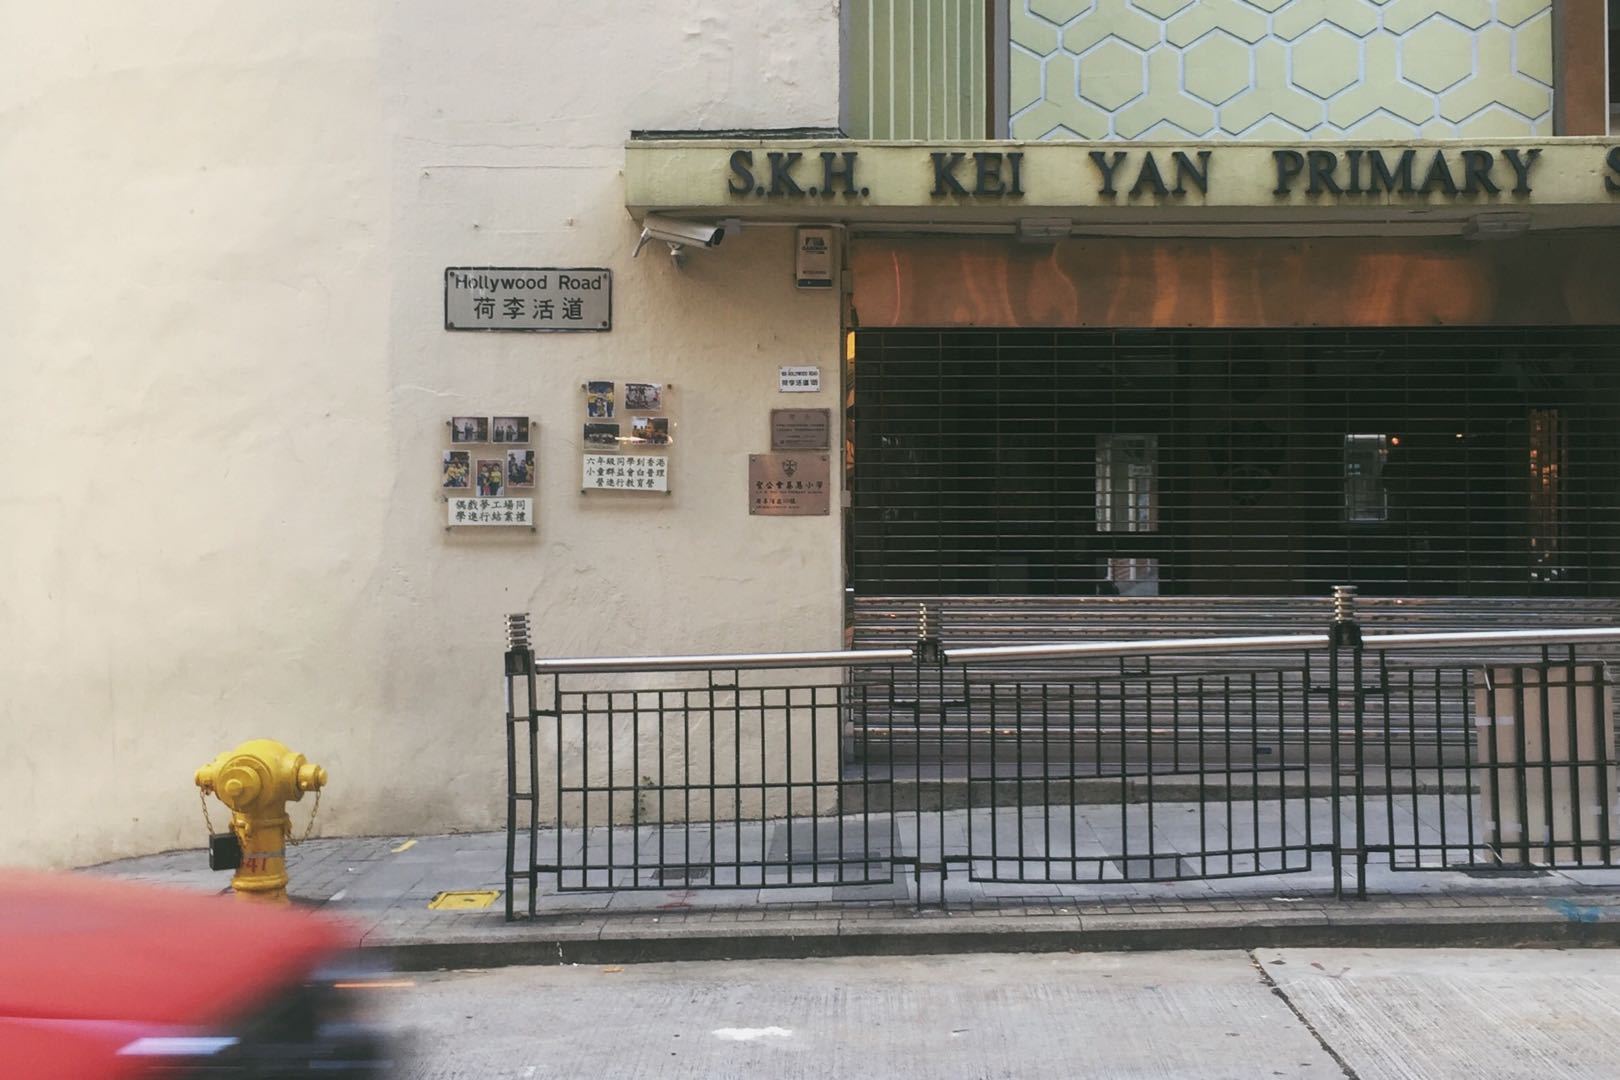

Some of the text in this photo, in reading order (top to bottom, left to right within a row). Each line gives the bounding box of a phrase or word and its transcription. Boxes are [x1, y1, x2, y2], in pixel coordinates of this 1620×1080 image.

[728, 150, 870, 197] S.K.H.
[930, 151, 1025, 196] KEI
[1088, 150, 1212, 196] YAN
[1272, 148, 1543, 196] PRIMARY
[455, 274, 602, 293] Hollywood Road
[473, 297, 584, 320] 荷李活道
[586, 456, 665, 468] 六年級同學到香港
